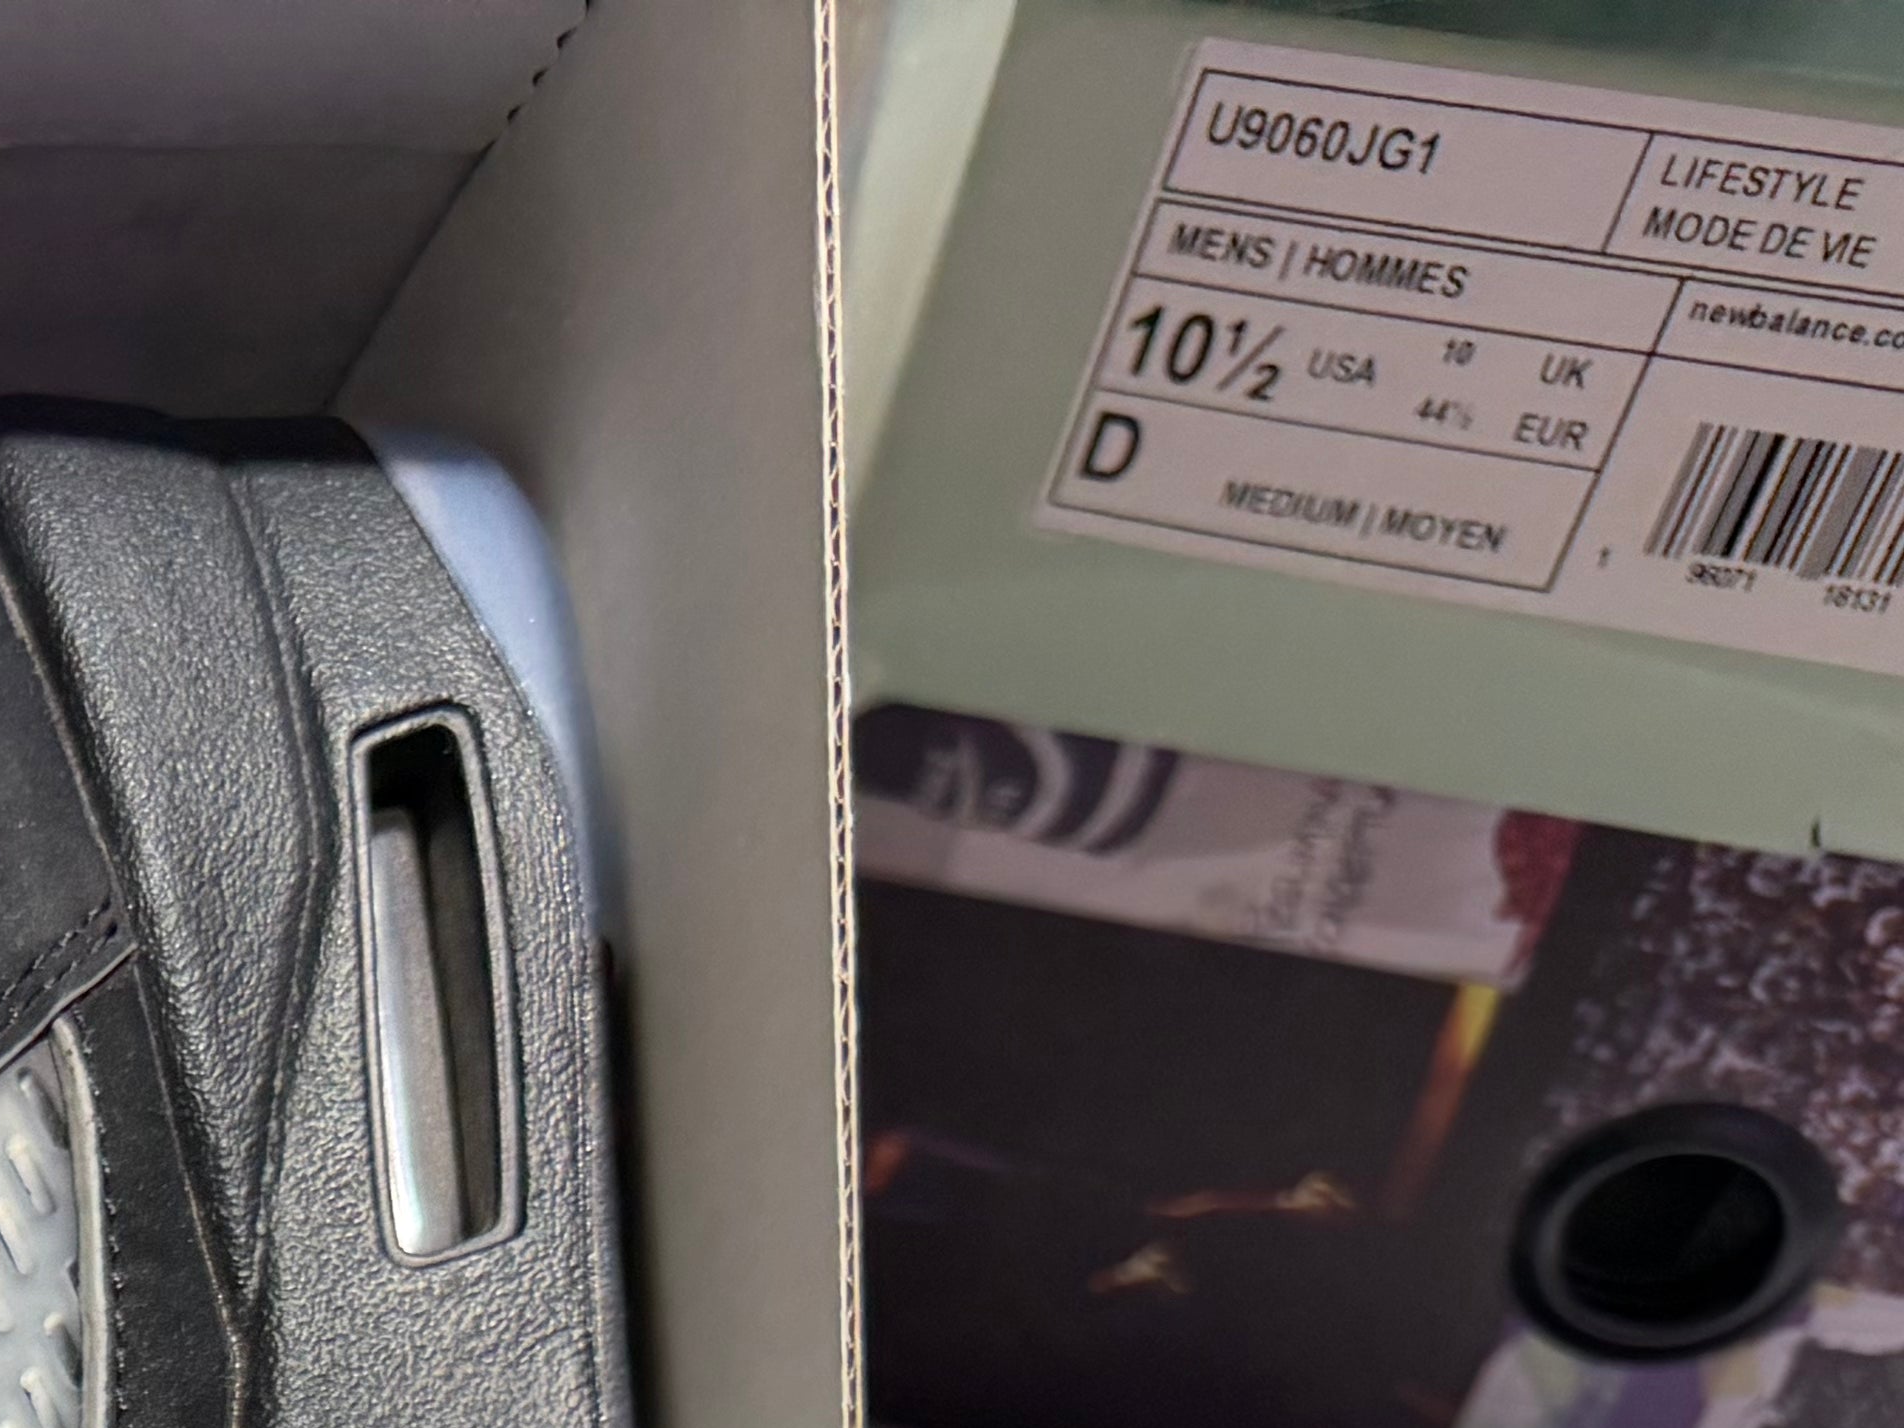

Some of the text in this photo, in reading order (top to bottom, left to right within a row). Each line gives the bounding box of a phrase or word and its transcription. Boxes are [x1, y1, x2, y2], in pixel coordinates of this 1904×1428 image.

[1208, 101, 1441, 174] U9060JG1
[1661, 154, 1864, 211] LIFESTYLE
[1167, 224, 1273, 269] MENS
[1303, 244, 1469, 298] HOMMES
[1643, 206, 1877, 269] MODE DE VIE
[1307, 348, 1377, 386] USA
[1540, 352, 1592, 389] UK
[1081, 411, 1141, 482] D
[1513, 412, 1588, 450] EUR
[1220, 481, 1358, 527] MEDIUM
[1380, 507, 1506, 552] MOYEN
